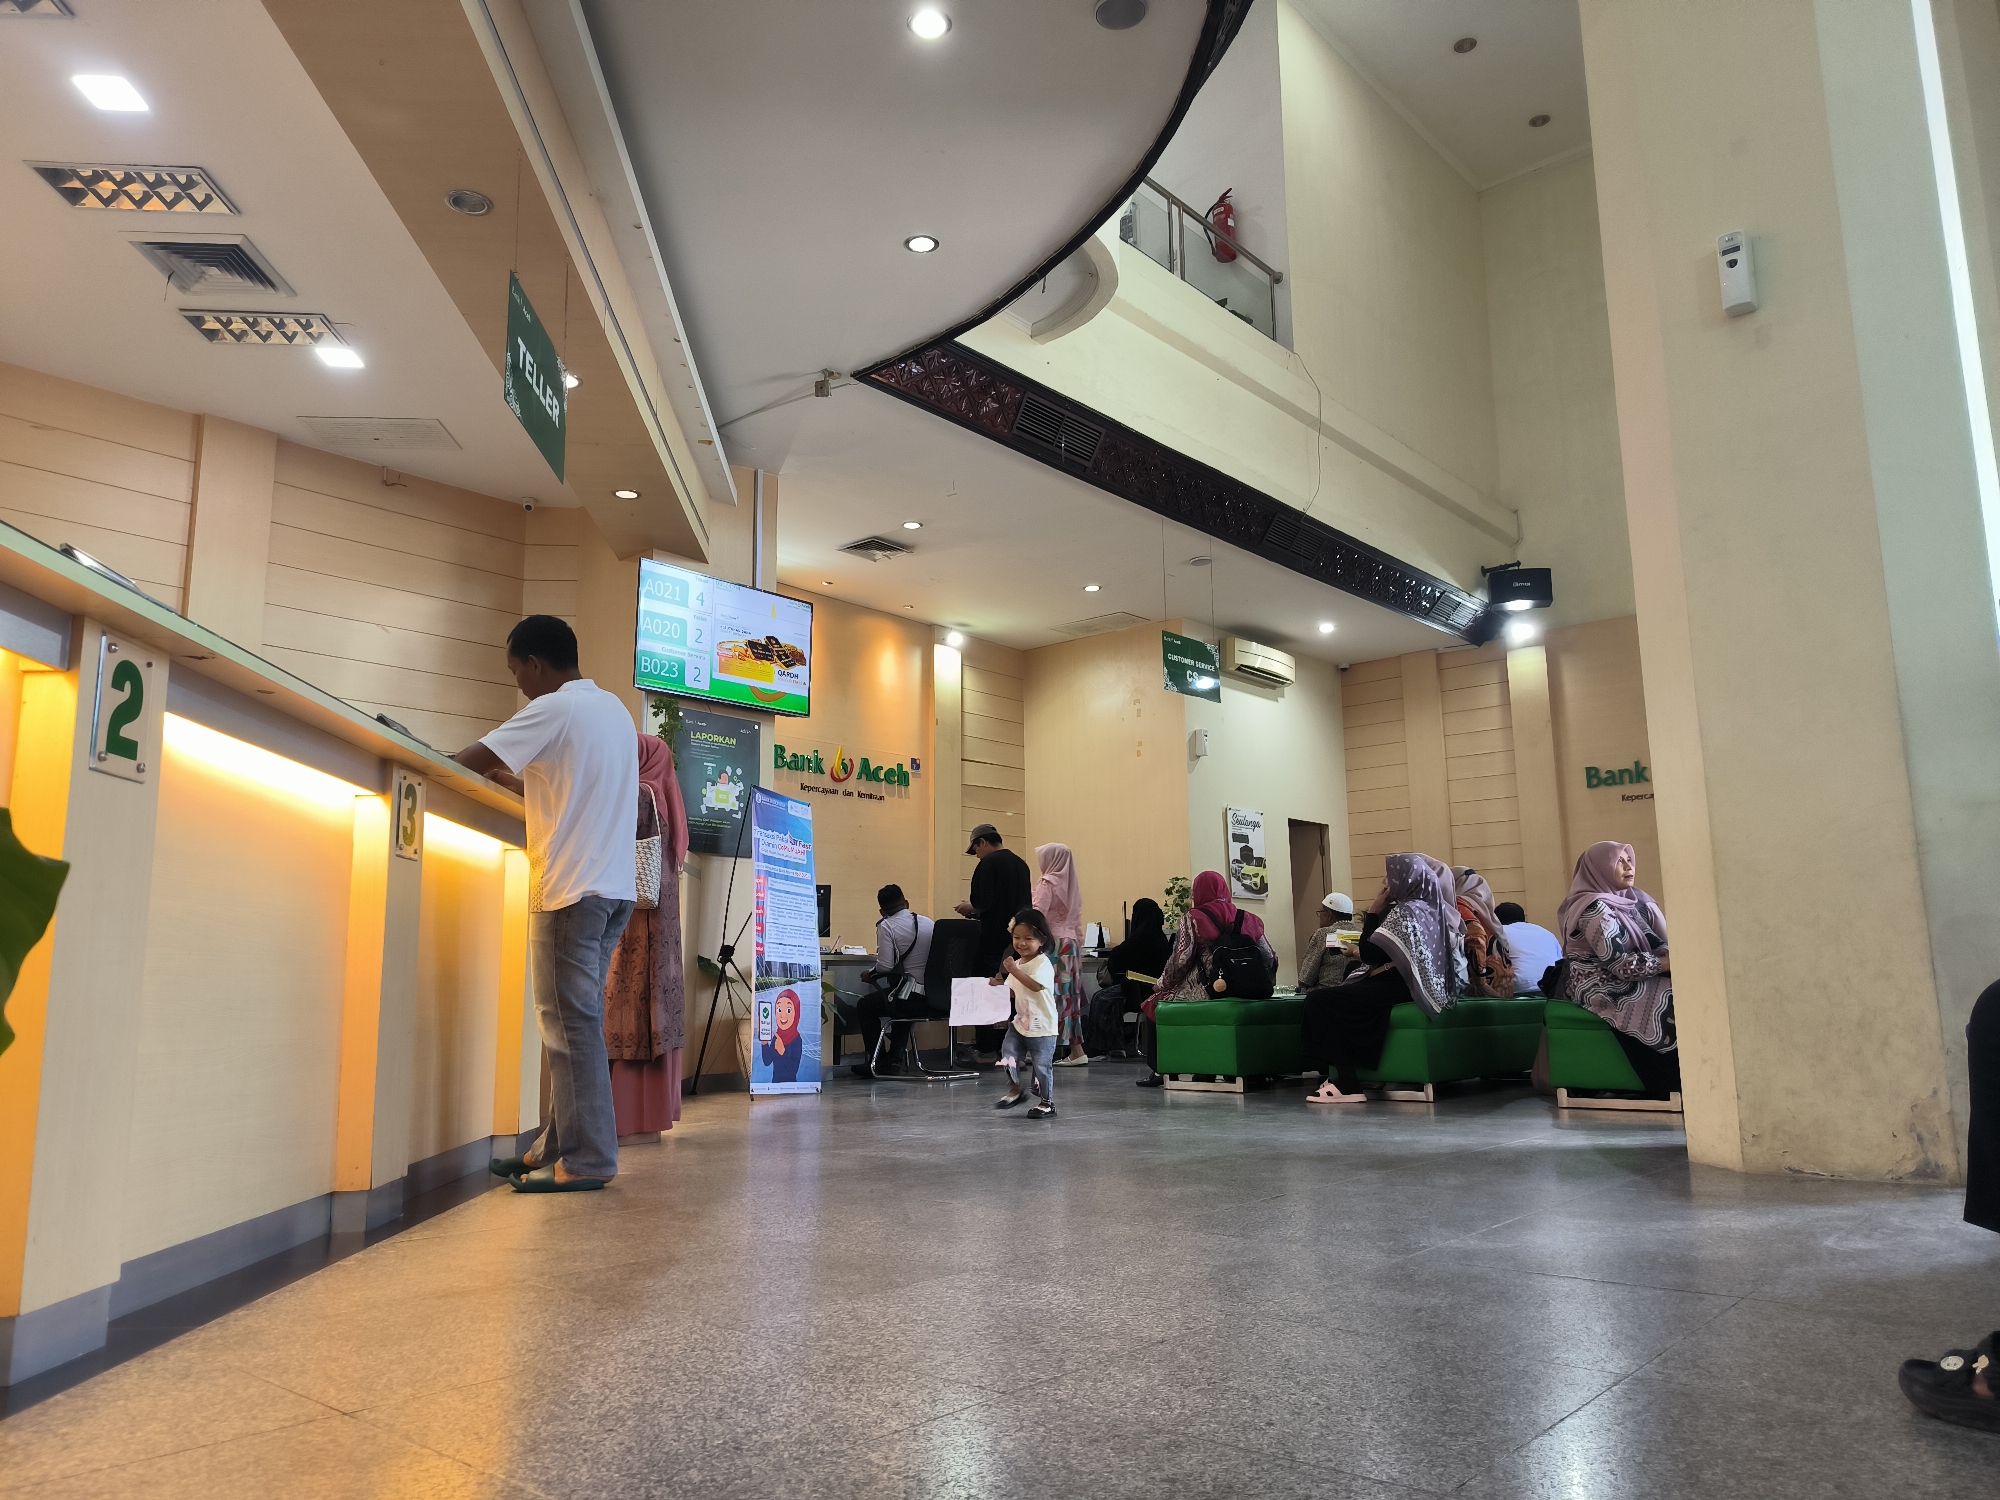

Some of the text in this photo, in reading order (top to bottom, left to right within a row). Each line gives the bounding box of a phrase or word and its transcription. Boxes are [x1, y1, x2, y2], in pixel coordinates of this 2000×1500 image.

[517, 335, 560, 430] TELLER
[643, 578, 681, 601] A021
[695, 591, 705, 607] 4
[641, 616, 681, 639] A020
[694, 628, 703, 644] 2
[661, 646, 706, 661] Customer Service
[1167, 653, 1215, 672] CUSTOMER SERVICE
[641, 655, 679, 678] B023
[693, 666, 702, 683] 2
[1186, 670, 1199, 683] CS
[105, 659, 144, 762] 2
[690, 730, 737, 746] LAPORKAN
[774, 744, 910, 787] Bank Aceh
[1585, 760, 1650, 789] Bank
[800, 782, 839, 796] Kepercayaan
[842, 788, 854, 798] dan
[401, 783, 418, 847] 3
